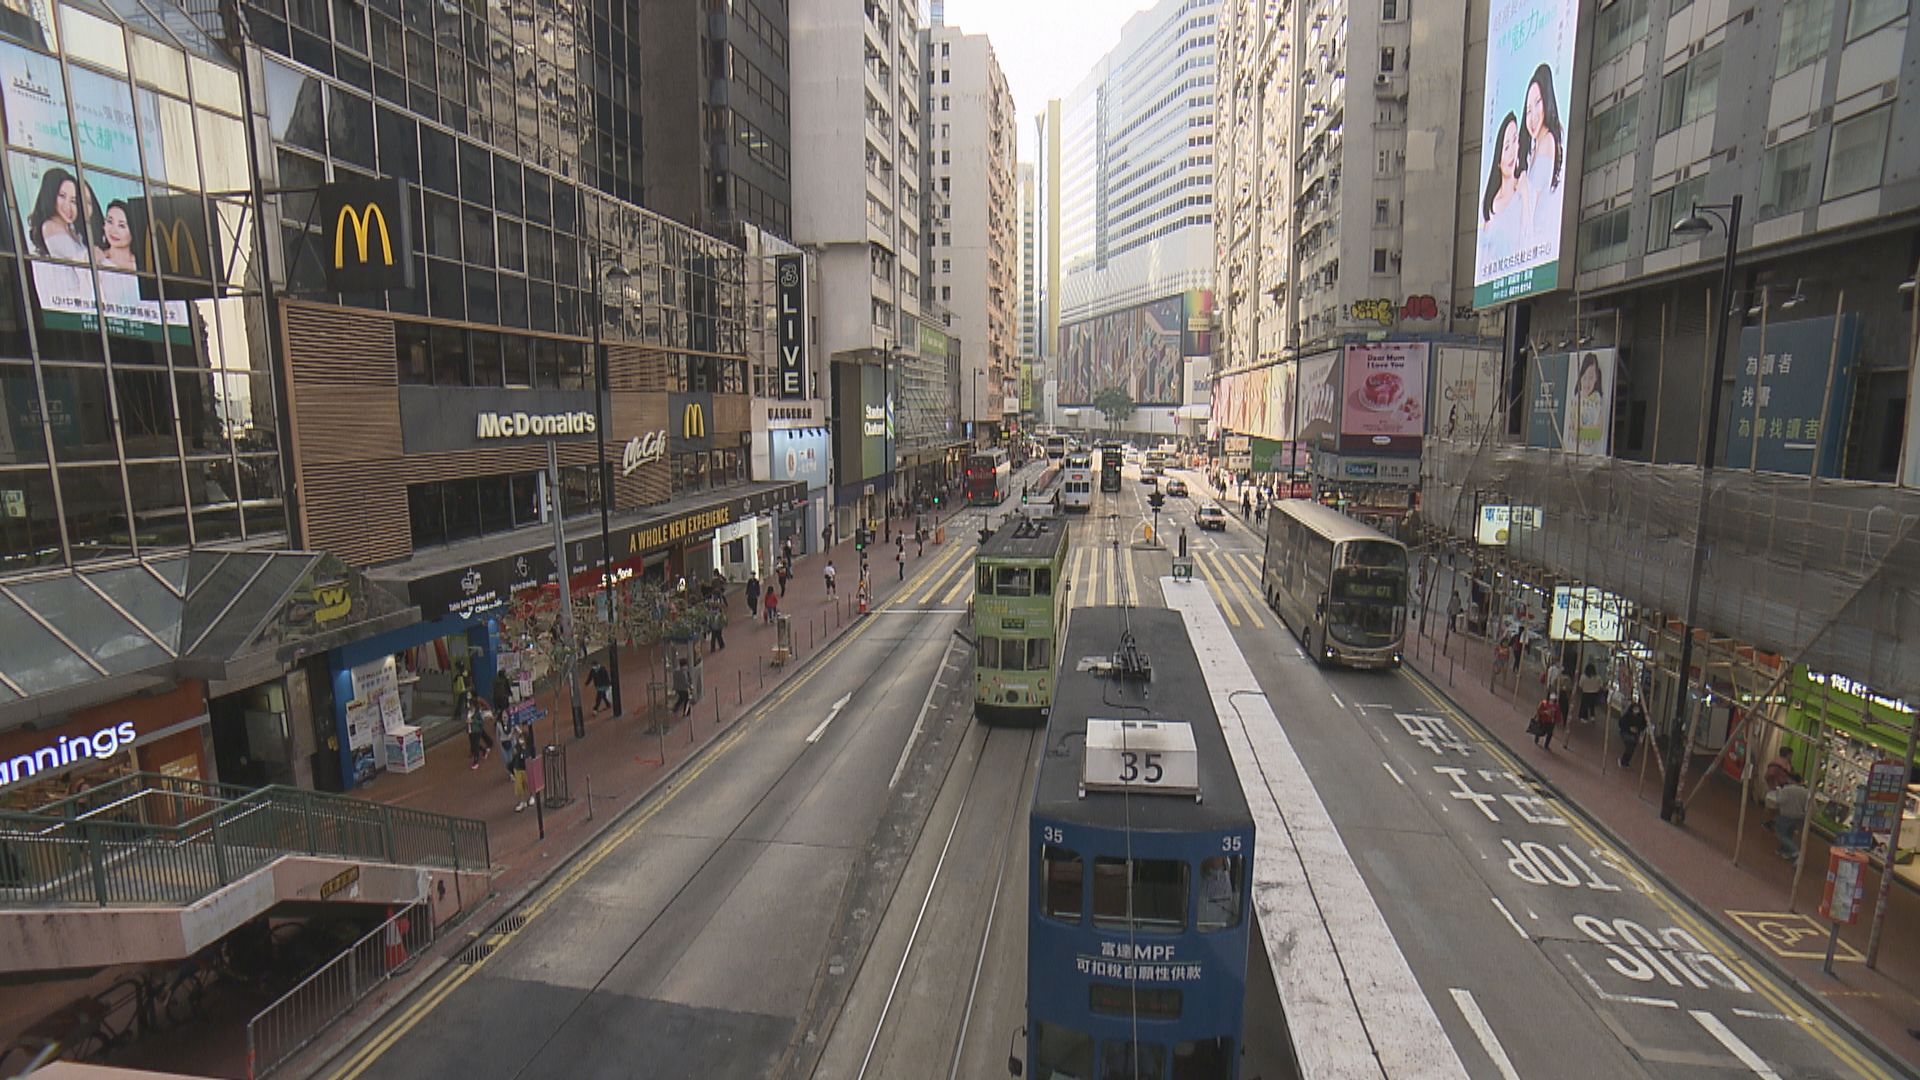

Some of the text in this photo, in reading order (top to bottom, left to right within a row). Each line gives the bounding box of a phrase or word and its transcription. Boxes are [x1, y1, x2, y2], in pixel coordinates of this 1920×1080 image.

[783, 294, 800, 393] LIVE
[1367, 354, 1405, 362] Dear Mum
[477, 411, 596, 438] McDonald's
[630, 506, 730, 553] A WHOLE NEW EXPERIENCE
[1119, 751, 1163, 783] 35
[1044, 826, 1064, 844] 35
[1221, 836, 1242, 852] 35
[1573, 914, 1754, 993] BUS
[1076, 958, 1202, 981] 可扣稅自願性供款
